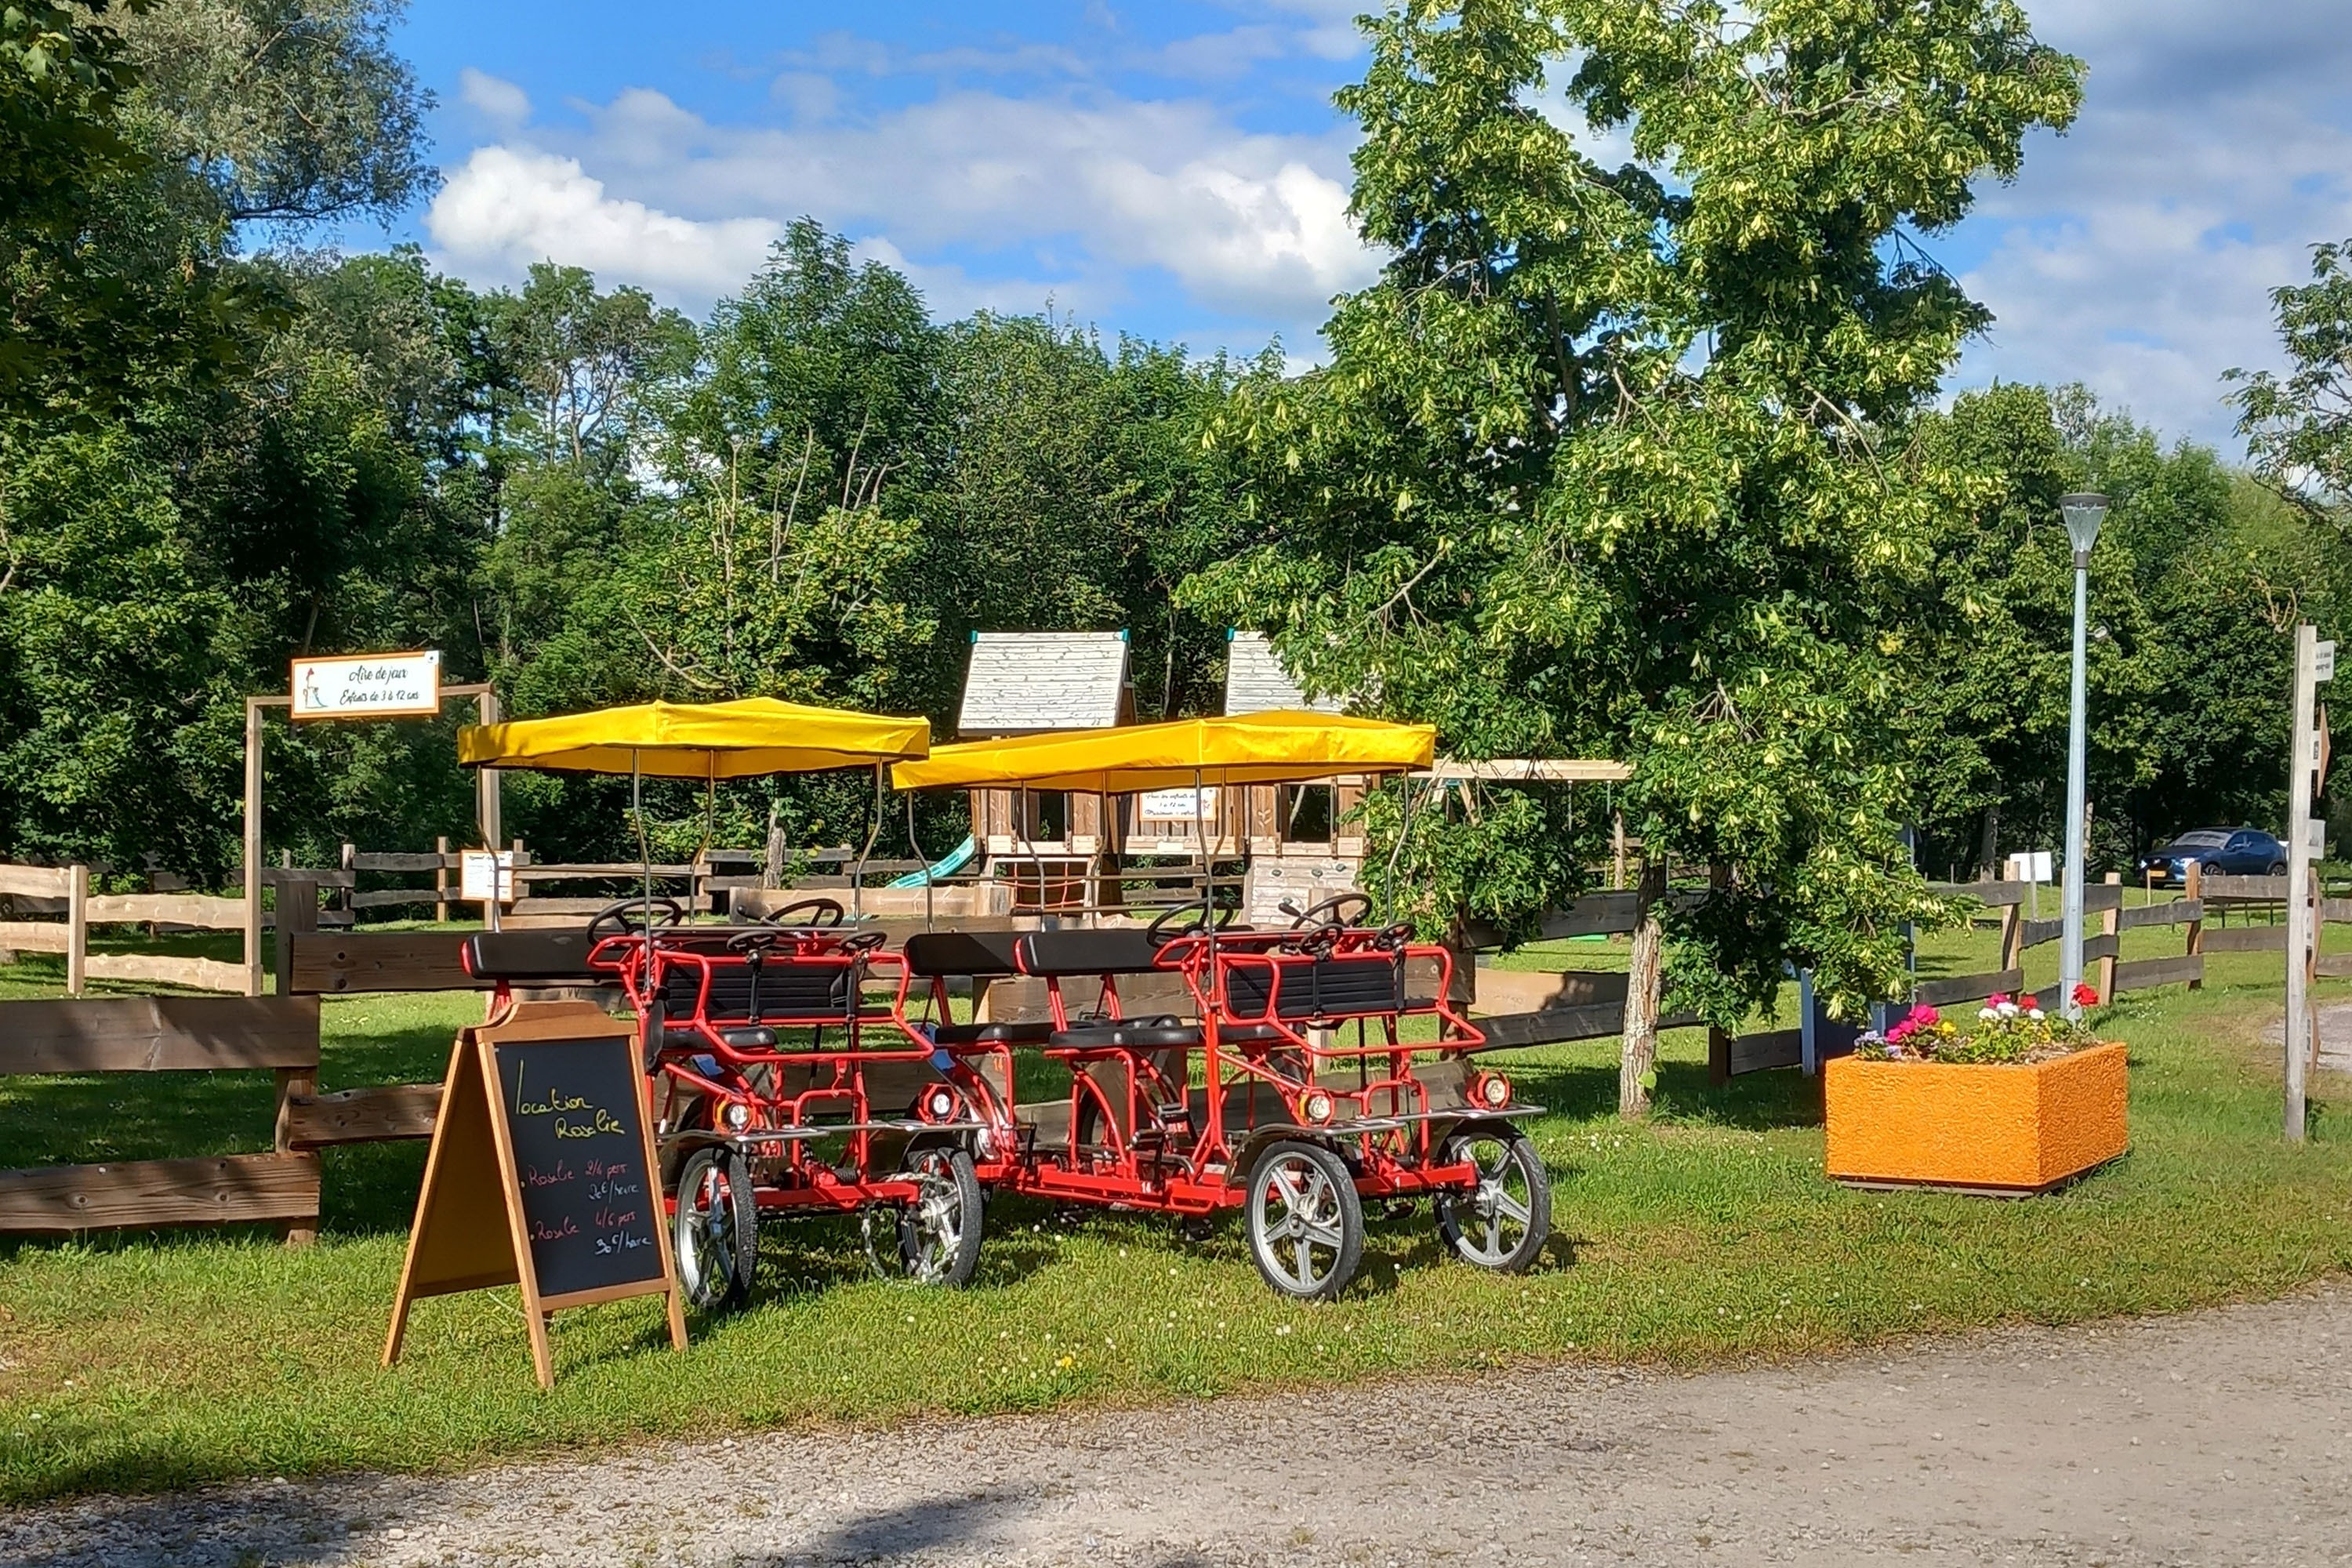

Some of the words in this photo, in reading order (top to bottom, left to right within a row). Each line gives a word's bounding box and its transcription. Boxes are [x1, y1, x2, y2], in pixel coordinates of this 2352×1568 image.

[349, 665, 373, 684] Aire
[376, 666, 387, 680] de
[381, 690, 387, 701] 3
[396, 690, 405, 700] 12
[555, 1109, 626, 1138] Rosalie
[528, 1159, 575, 1186] Rosalie
[1142, 1181, 1152, 1193] 14
[595, 1206, 615, 1228] 4/6
